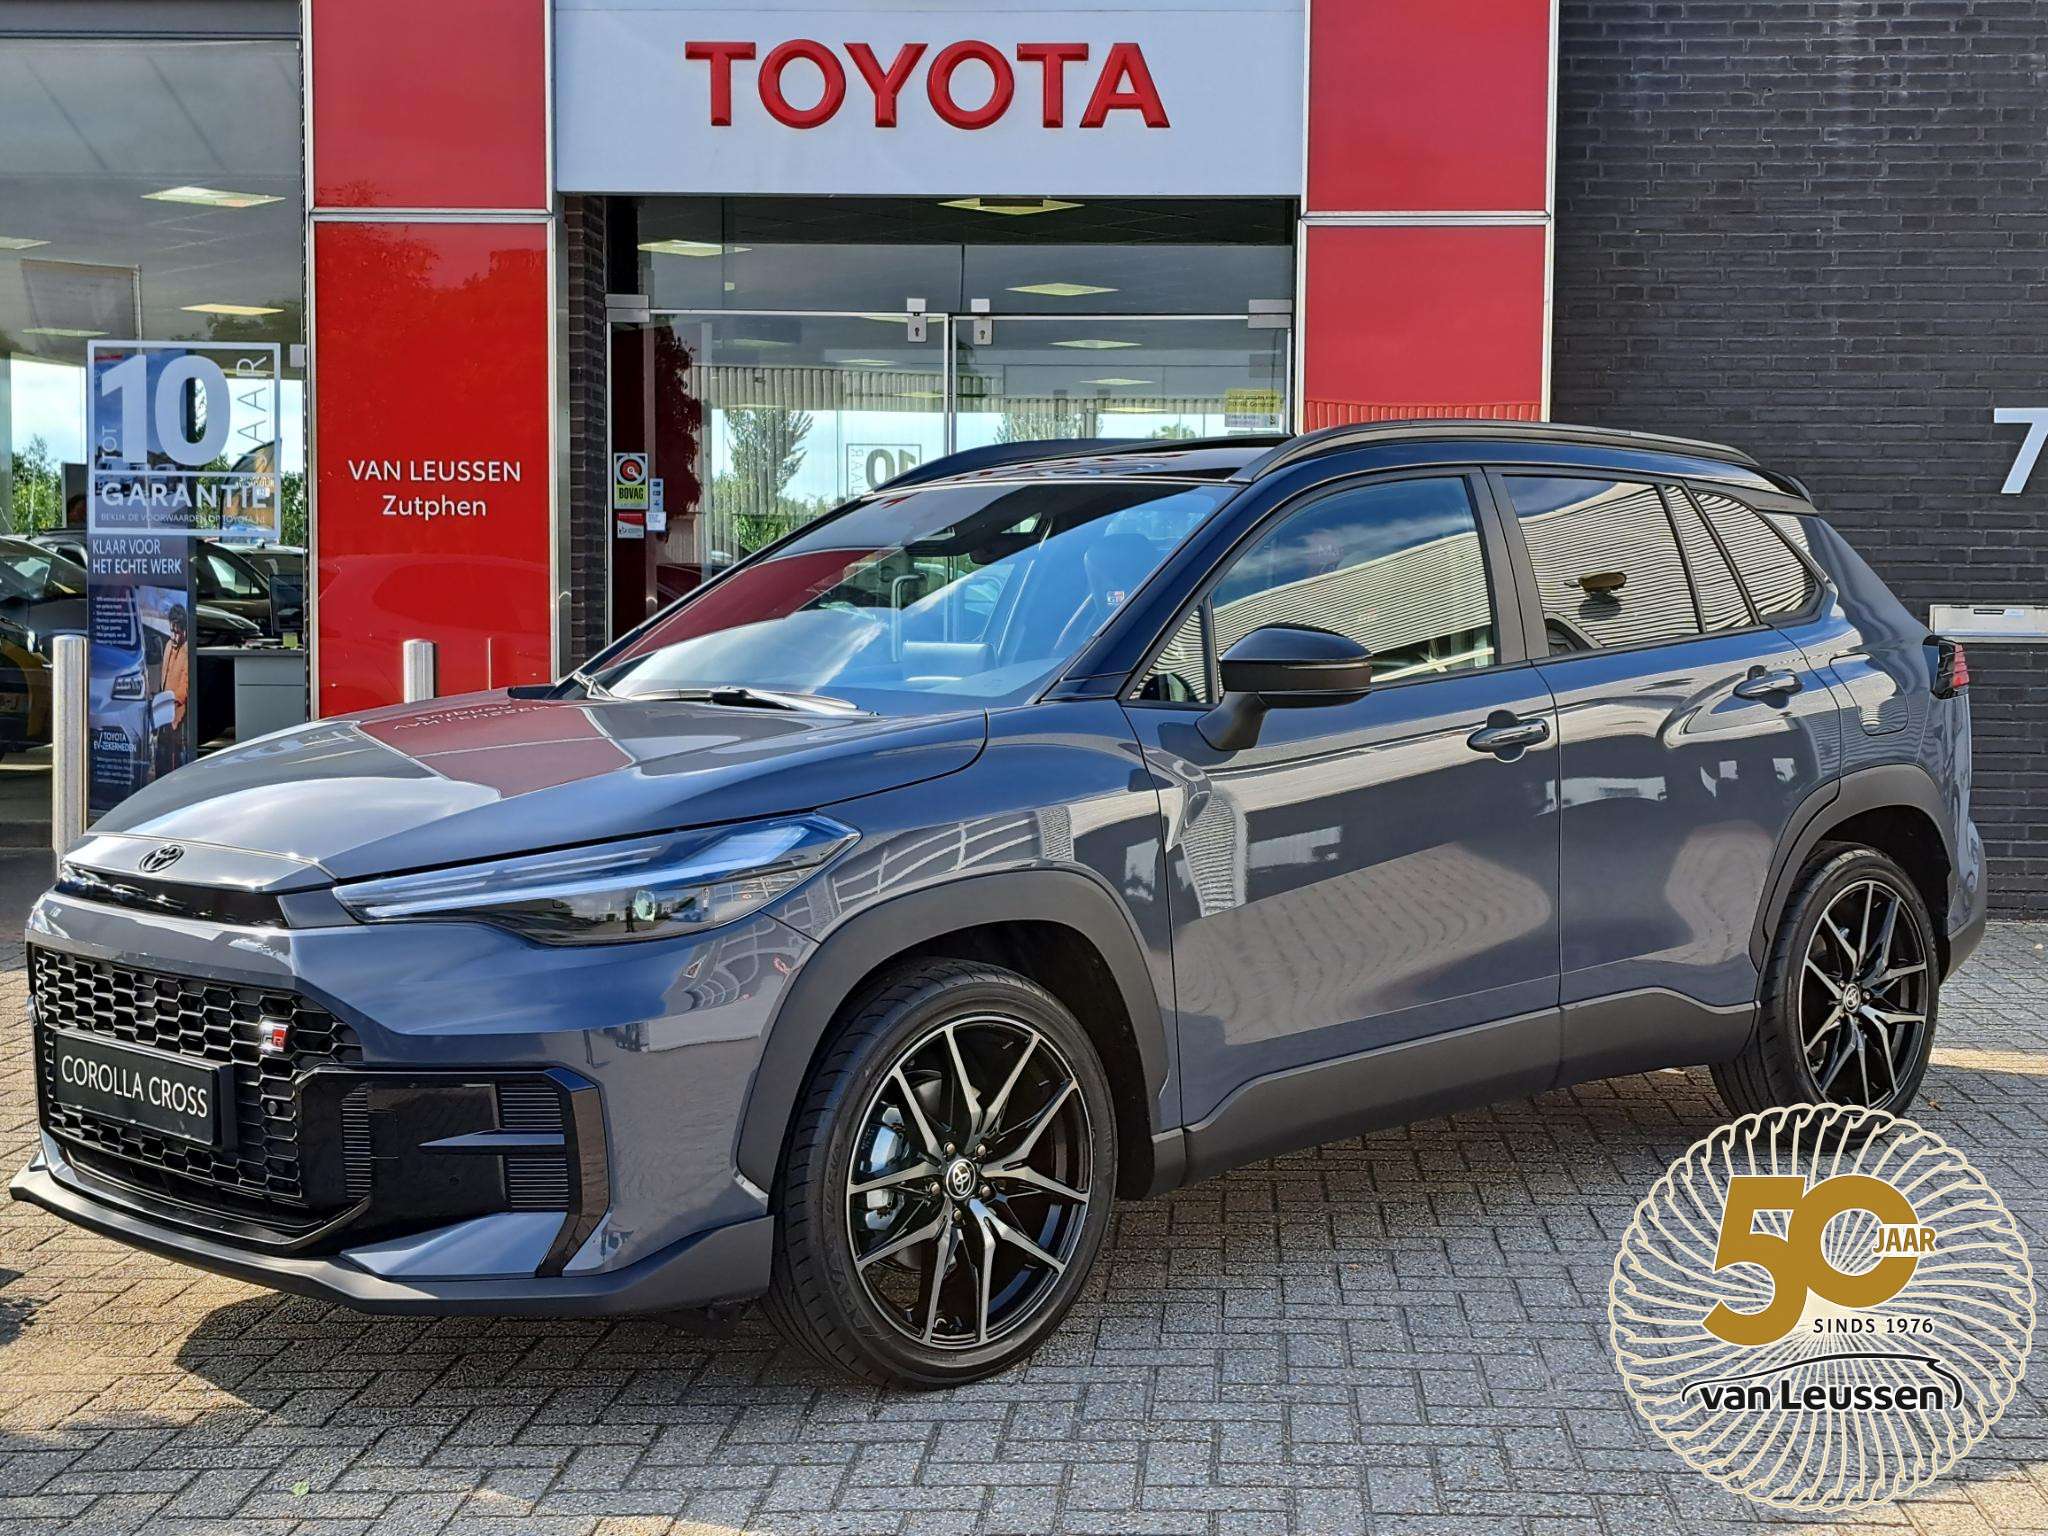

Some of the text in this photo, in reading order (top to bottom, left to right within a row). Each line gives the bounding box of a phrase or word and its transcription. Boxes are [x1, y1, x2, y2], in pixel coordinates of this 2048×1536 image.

[685, 38, 1171, 130] TOYOTA
[101, 355, 231, 467] 10
[1993, 407, 2048, 494] 7
[347, 459, 521, 482] VAN LEUSSEN
[101, 481, 268, 509] GARANTIE
[618, 487, 644, 500] BOVAG
[128, 512, 138, 522] DE
[382, 494, 487, 521] Zutphen
[92, 539, 161, 555] KLAAR VOOR
[92, 558, 182, 574] HET ECHTE WERK
[103, 732, 127, 742] TOYOTA
[60, 1053, 208, 1118] COROLLA CROSS
